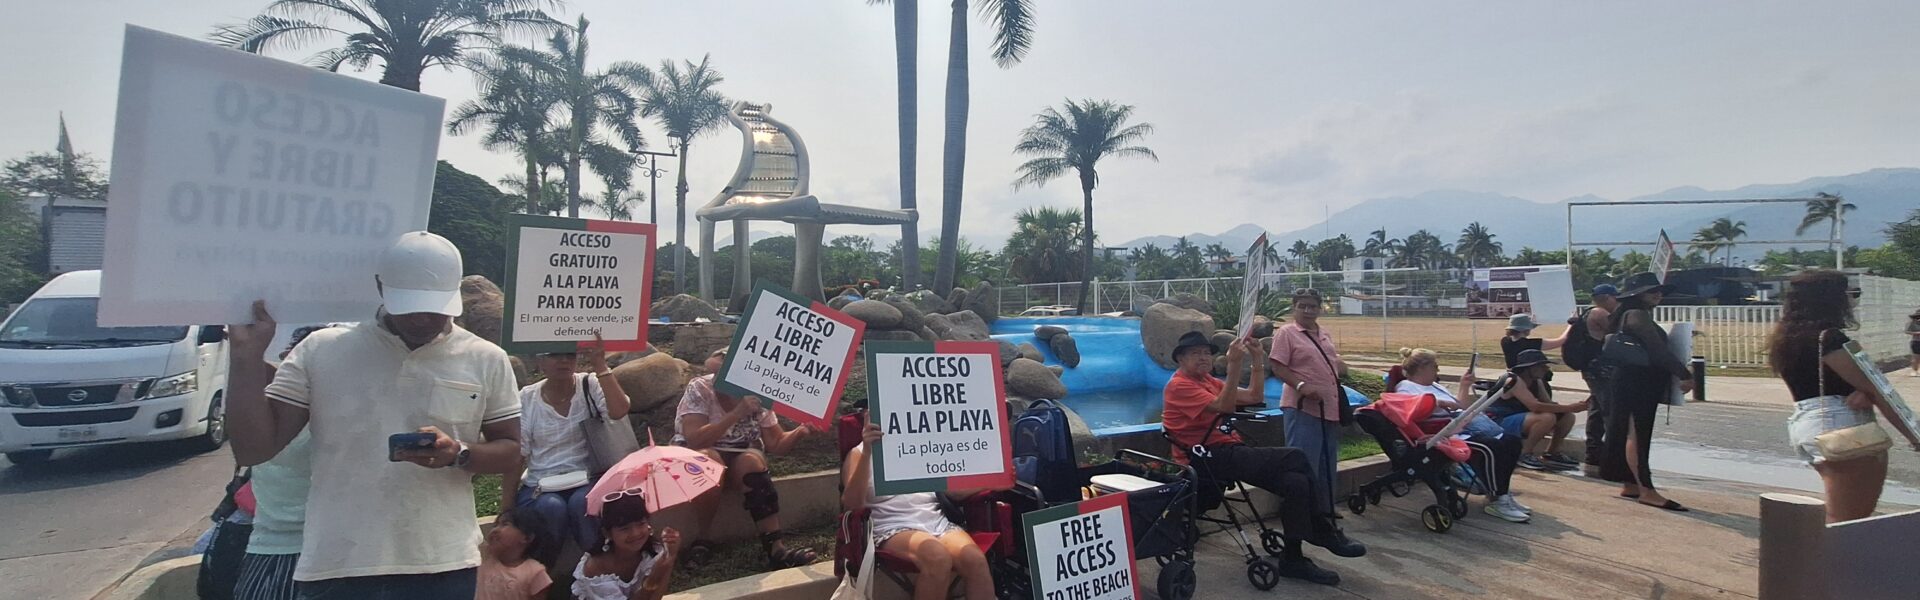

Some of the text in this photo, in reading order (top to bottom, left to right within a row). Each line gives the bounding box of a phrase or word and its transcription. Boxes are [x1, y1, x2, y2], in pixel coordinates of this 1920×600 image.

[560, 232, 611, 249] ACCESO
[549, 253, 618, 269] GRATUITO
[543, 274, 619, 289] A LA PLAYA
[537, 295, 622, 310] PARA TODOS
[520, 313, 634, 324] El mar no se vende, ¡se
[776, 302, 835, 338] ACCESO
[774, 323, 823, 356] LIBRE
[744, 335, 833, 384] A LA PLAYA
[902, 356, 971, 378] ACCESO
[744, 360, 820, 397] ¡La playa es de
[760, 383, 795, 404] todos!
[911, 383, 967, 405] LIBRE
[888, 409, 994, 435] A LA PLAYA
[898, 438, 988, 458] ¡La playa es de
[926, 459, 966, 474] todos!
[1060, 513, 1104, 548] FREE
[1056, 540, 1116, 582] ACCESS
[1065, 580, 1091, 600] THE
[1092, 568, 1129, 597] BEACH
